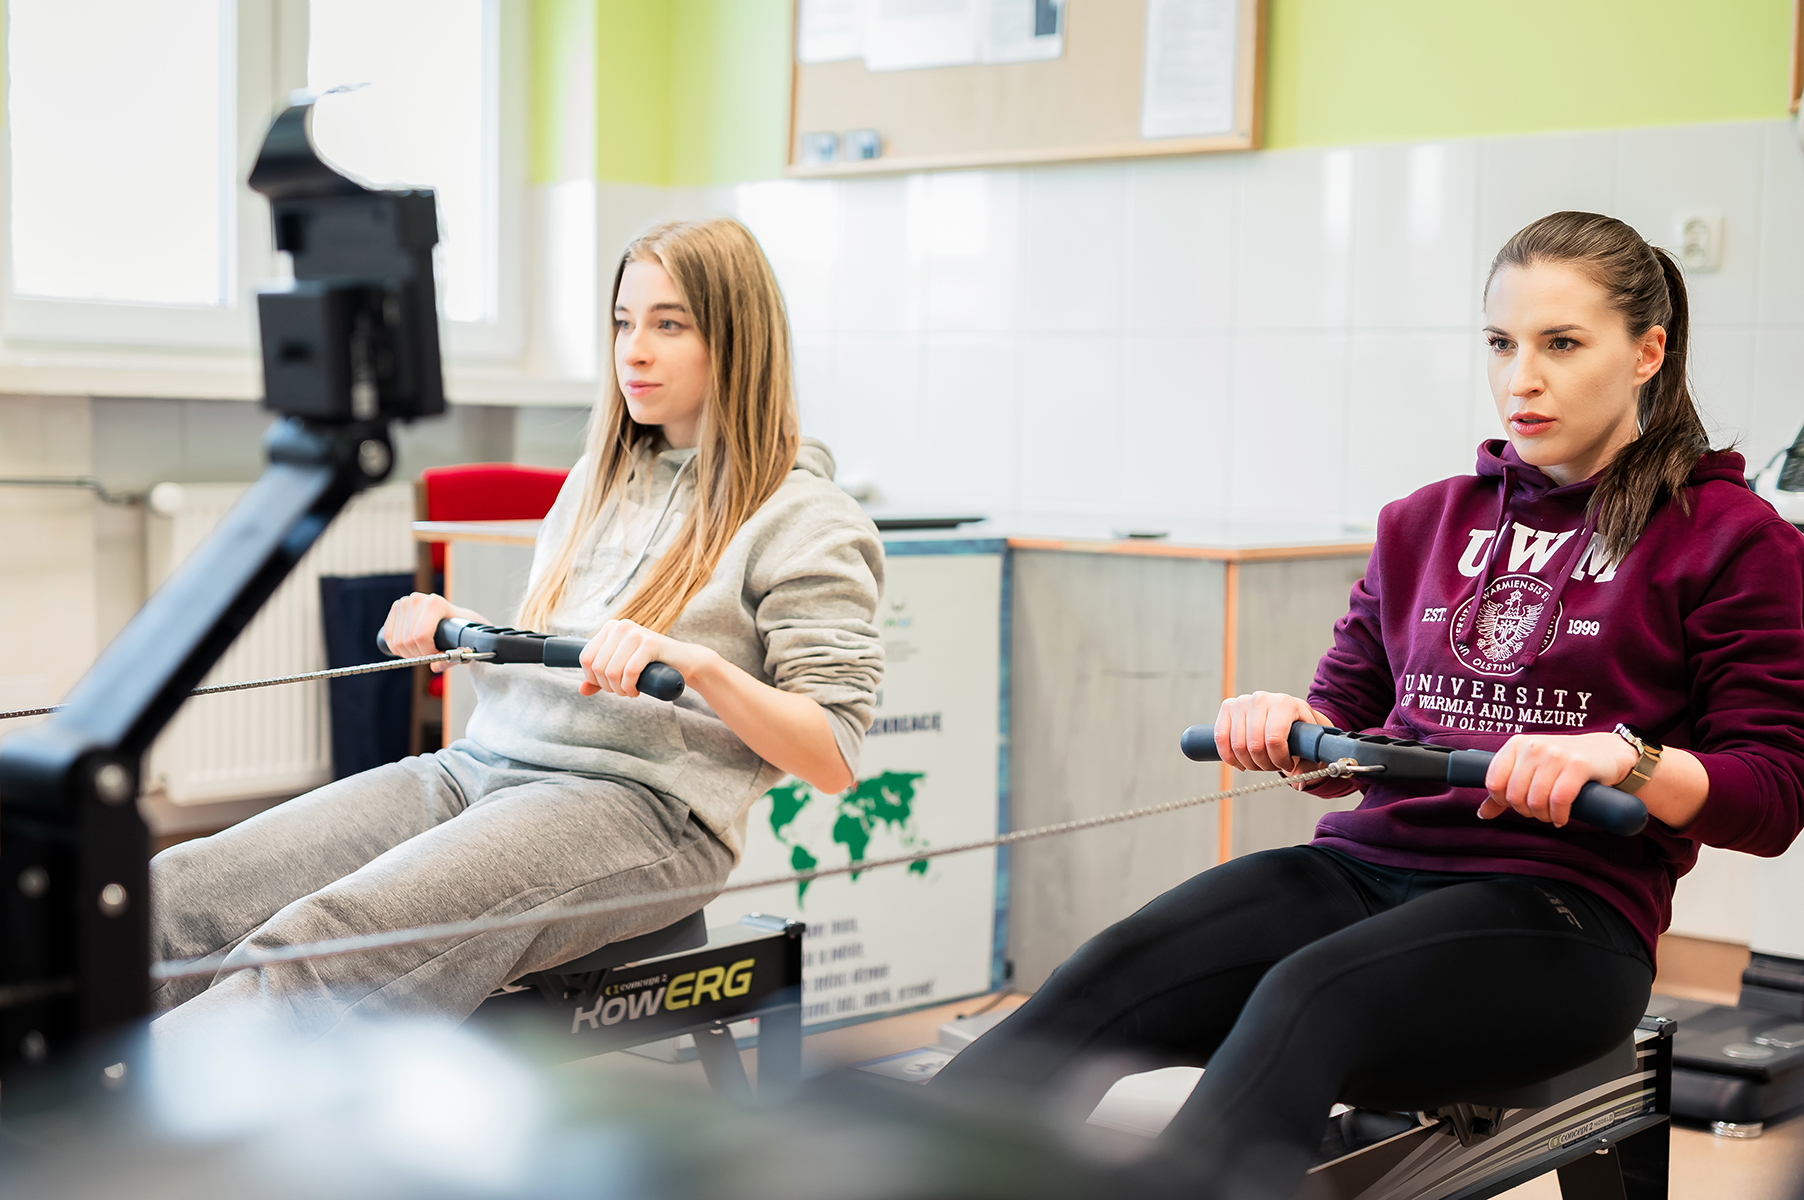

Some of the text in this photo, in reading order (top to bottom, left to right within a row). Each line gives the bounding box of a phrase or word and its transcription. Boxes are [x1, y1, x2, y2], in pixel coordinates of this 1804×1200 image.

[1457, 521, 1639, 583] UWM
[1482, 580, 1543, 600] WARMIENSIS
[1422, 607, 1447, 622] EST.
[1567, 619, 1600, 637] 1999
[1472, 658, 1516, 672] OLSTINI
[1404, 673, 1593, 710] UNIVERSITY
[1400, 693, 1588, 728] OF WARMIA AND MAZURY
[1439, 714, 1524, 734] IN OLSZTYN
